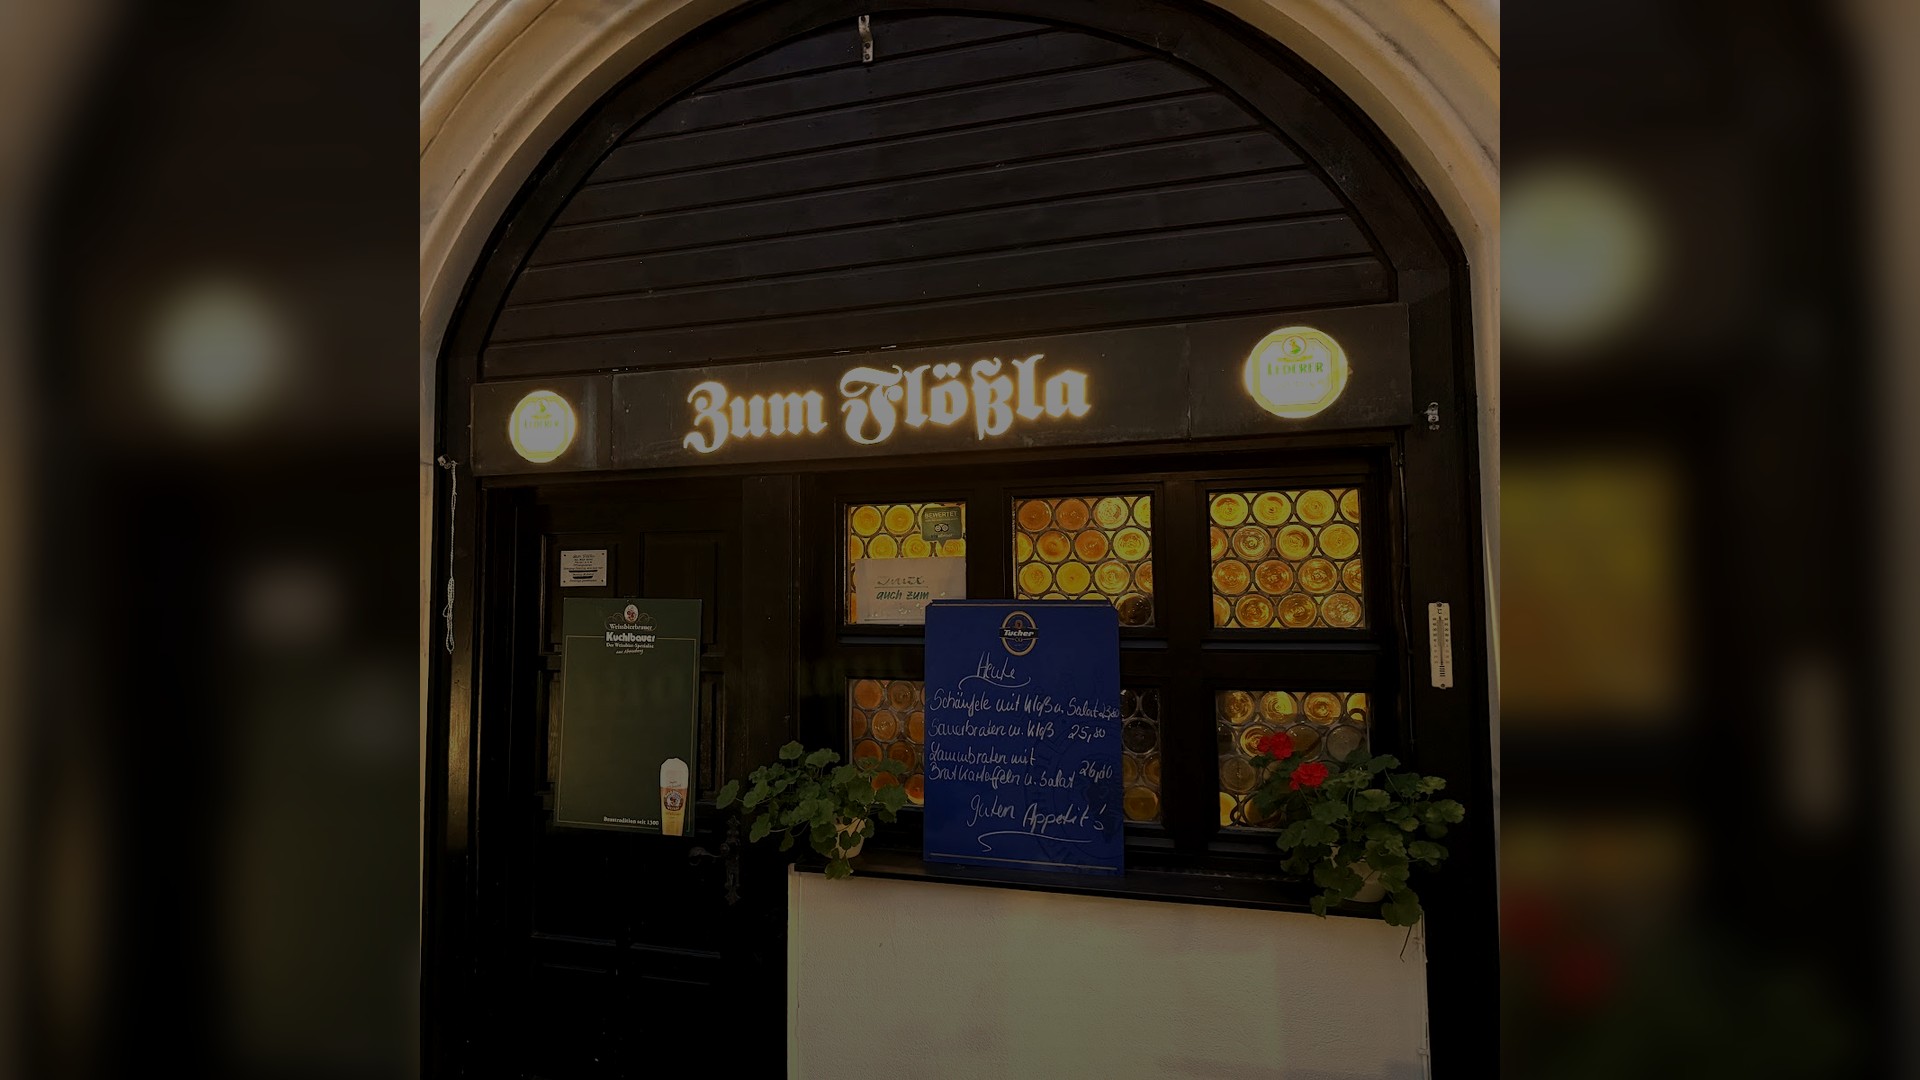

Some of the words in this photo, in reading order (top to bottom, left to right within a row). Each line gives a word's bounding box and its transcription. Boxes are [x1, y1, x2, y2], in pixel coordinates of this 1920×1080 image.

[683, 381, 828, 454] Zum
[839, 354, 1092, 445] Flößla
[876, 590, 903, 600] auch
[906, 591, 930, 600] zum
[606, 632, 656, 642] Kuchlbauer
[1003, 629, 1035, 637] Tucher
[976, 651, 1017, 681] Heute
[929, 687, 993, 718] Schäufele
[995, 692, 1021, 713] mit
[1066, 696, 1099, 718] Salat
[927, 717, 1006, 737] Sauerbraten
[928, 741, 1008, 765] Lammbraten
[1010, 747, 1037, 766] mit
